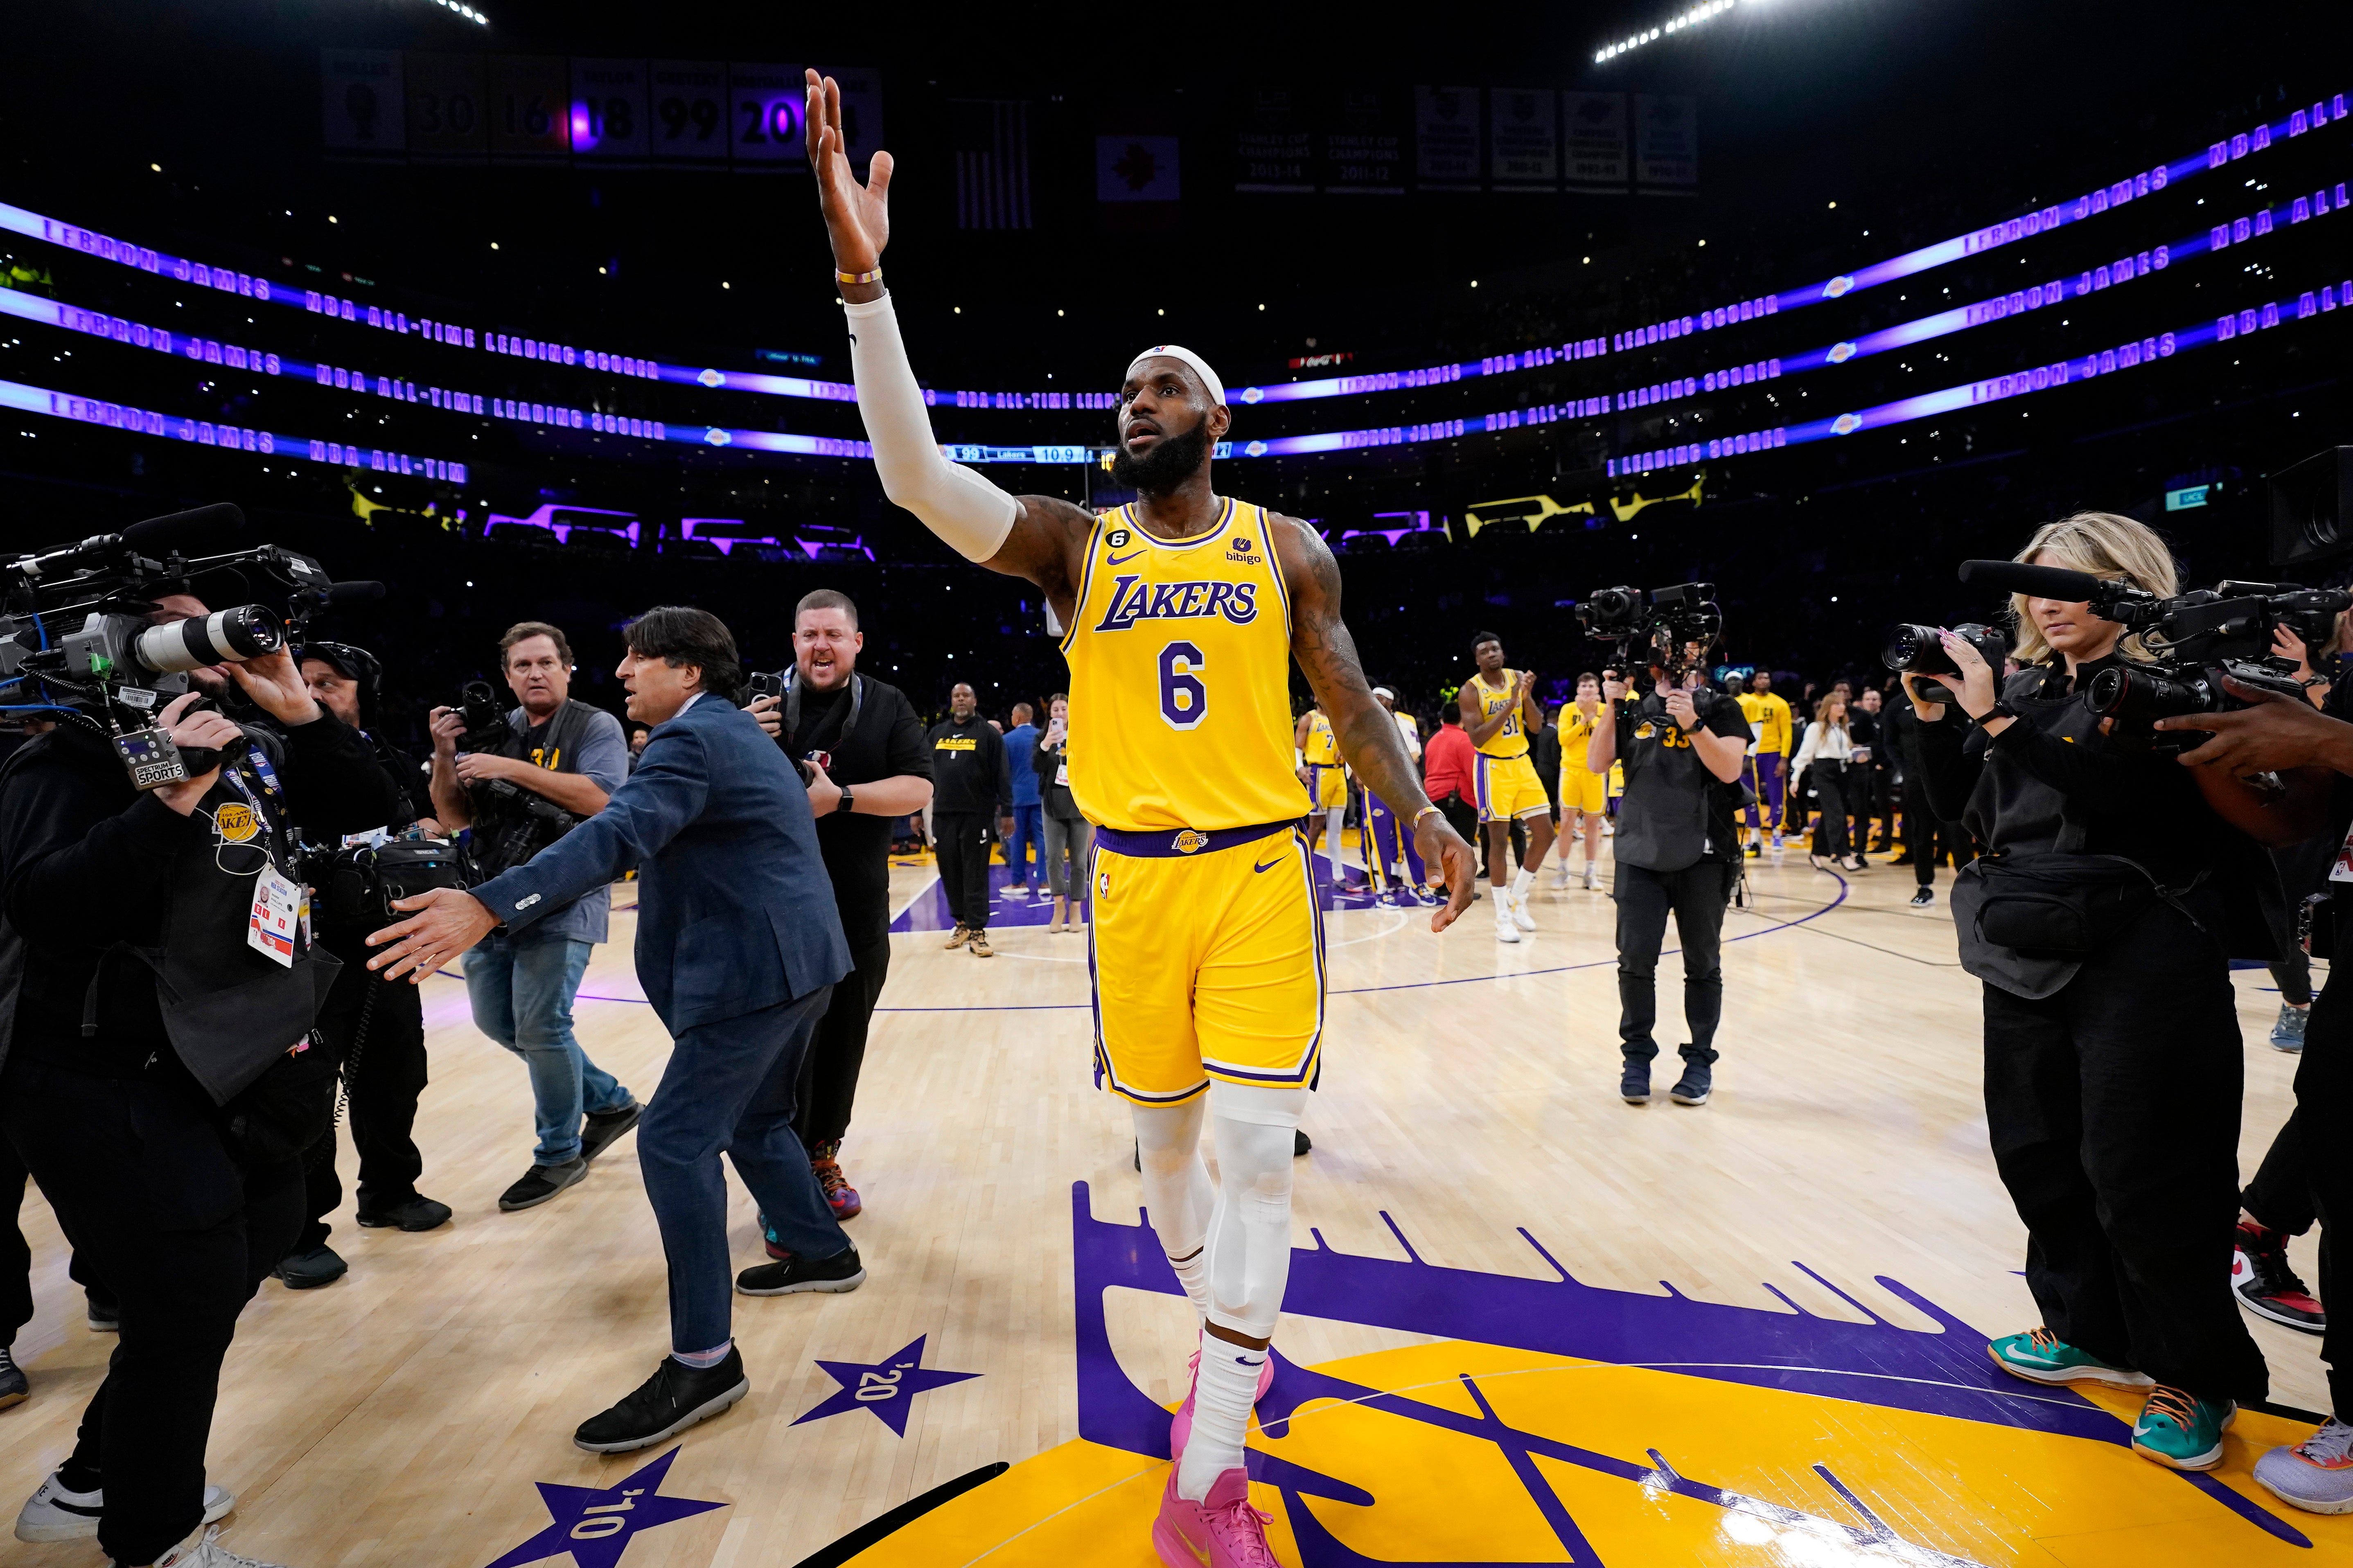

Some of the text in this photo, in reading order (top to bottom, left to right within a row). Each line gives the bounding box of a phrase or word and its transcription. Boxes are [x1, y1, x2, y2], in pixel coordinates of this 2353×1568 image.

[658, 97, 718, 141] 99
[739, 100, 796, 143] 20
[2074, 165, 2167, 221] JAMES
[2209, 124, 2271, 169] NBA
[2076, 245, 2170, 296] JAMES
[2211, 209, 2273, 252] NBA
[174, 258, 271, 300] JAMES
[305, 291, 356, 322] NBA
[368, 306, 475, 349] ALL-TIME
[485, 332, 575, 366] LEADING
[584, 350, 659, 381] SCORER
[1405, 363, 1461, 388] JAMES
[1482, 353, 1517, 376] NBA
[1523, 336, 1607, 369] ALL-TIME
[1615, 316, 1693, 353] LEADING
[1701, 294, 1779, 331] SCORER
[2082, 332, 2175, 379] JAMES
[2216, 302, 2279, 342] NBA
[186, 338, 281, 376] JAMES
[316, 363, 365, 393] NBA
[377, 376, 483, 415] ALL-TIME
[494, 398, 584, 429] LEADING
[591, 412, 666, 442] SCORER
[957, 390, 988, 408] NBA
[996, 391, 1070, 409] ALL-TIME
[1076, 392, 1120, 409] LEAD
[1408, 419, 1464, 443] JAMES
[1485, 409, 1520, 432] NBA
[1527, 394, 1611, 425] ALL-TIME
[1617, 376, 1697, 412] LEADING
[1704, 358, 1781, 392] SCORER
[179, 419, 275, 455] JAMES
[309, 439, 359, 467] NBA
[961, 447, 980, 460] 99
[1042, 448, 1073, 461] 10.9
[1622, 443, 1701, 475] LEADING
[1709, 427, 1786, 459] SCORER
[1111, 532, 1124, 545] 6
[1226, 551, 1261, 565] bibigo
[1093, 573, 1259, 633] LAKERS
[1157, 640, 1208, 731] 6
[1317, 723, 1331, 732] LAK
[1326, 734, 1334, 750] 7
[1502, 714, 1519, 738] 31
[136, 762, 169, 775] SPECTRUM
[138, 765, 183, 785] SPORTS
[249, 751, 267, 764] NBA
[263, 774, 280, 787] NBA
[214, 813, 257, 831] LAKER
[1175, 837, 1206, 848] LAKERS
[277, 884, 287, 897] SEASON
[854, 1361, 914, 1402] '20
[569, 1488, 645, 1540] '10
